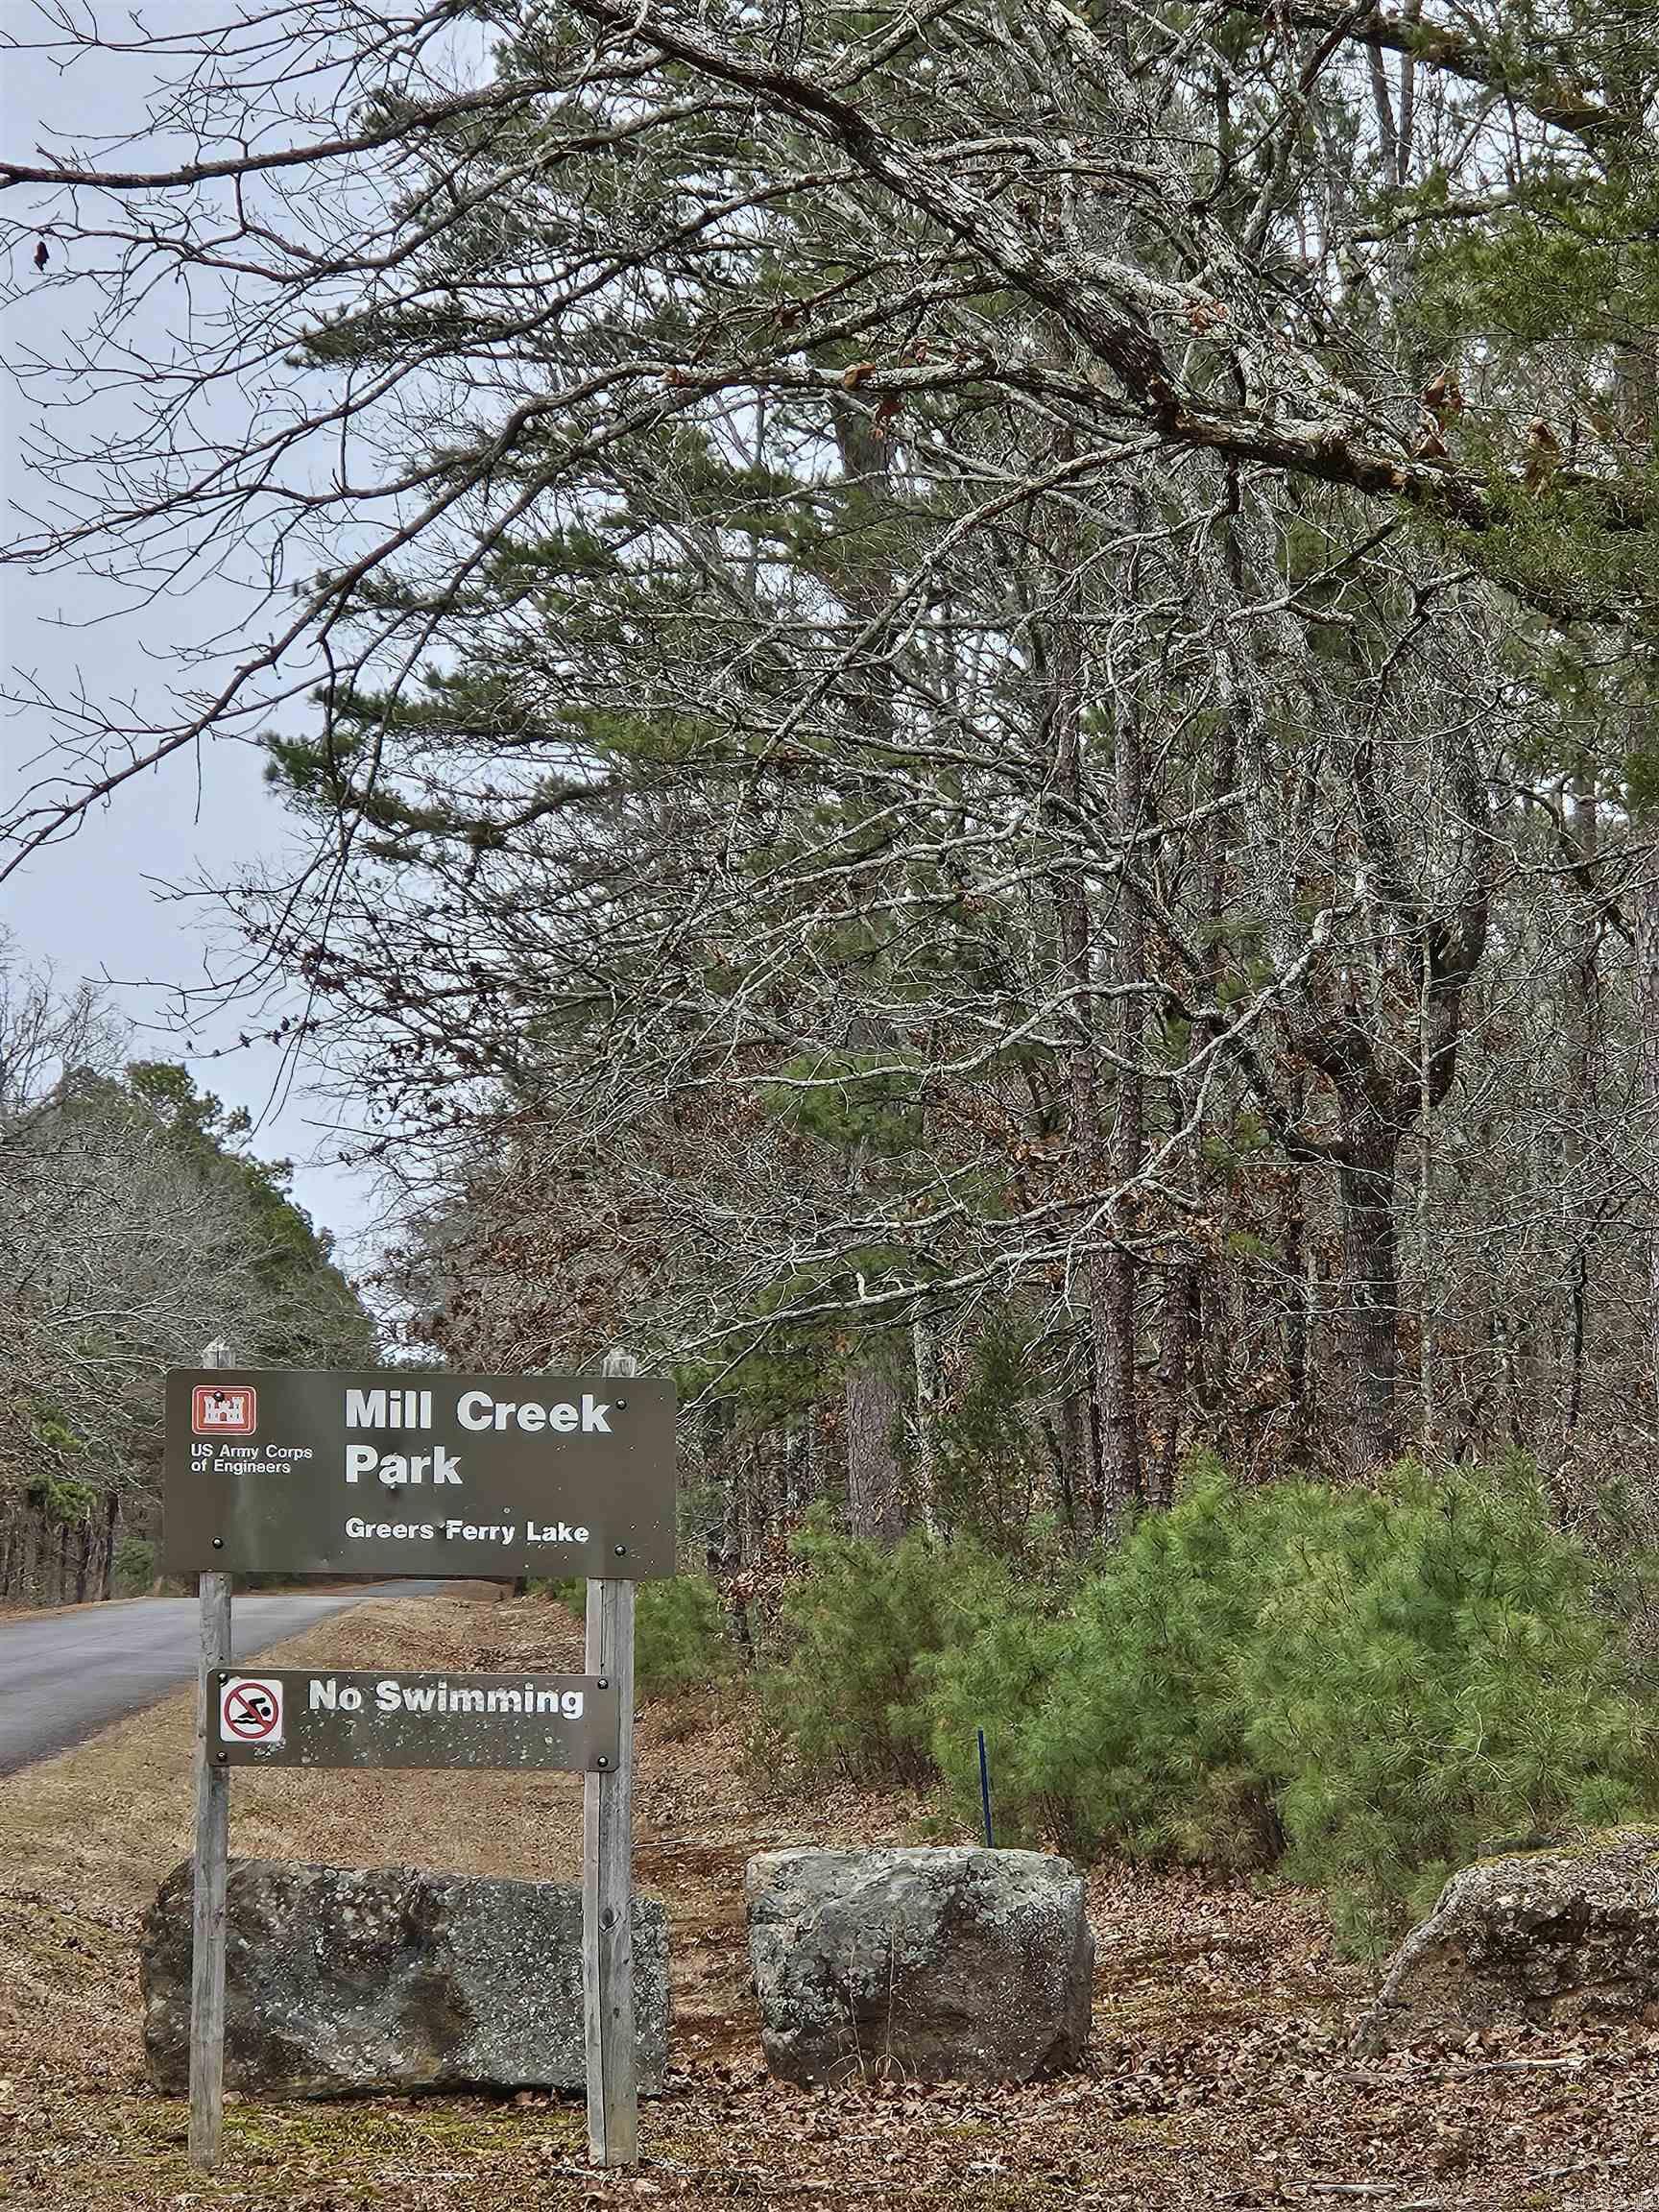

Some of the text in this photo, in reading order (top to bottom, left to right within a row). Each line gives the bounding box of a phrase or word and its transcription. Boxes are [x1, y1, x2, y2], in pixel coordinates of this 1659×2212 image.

[346, 1388, 613, 1432] Mill Creek
[190, 1443, 313, 1461] US Army Corps
[191, 1458, 291, 1476] of Engineers
[346, 1444, 464, 1484] Park
[345, 1517, 589, 1546] Greers Ferry Lake
[309, 1679, 585, 1719] No Swimming
